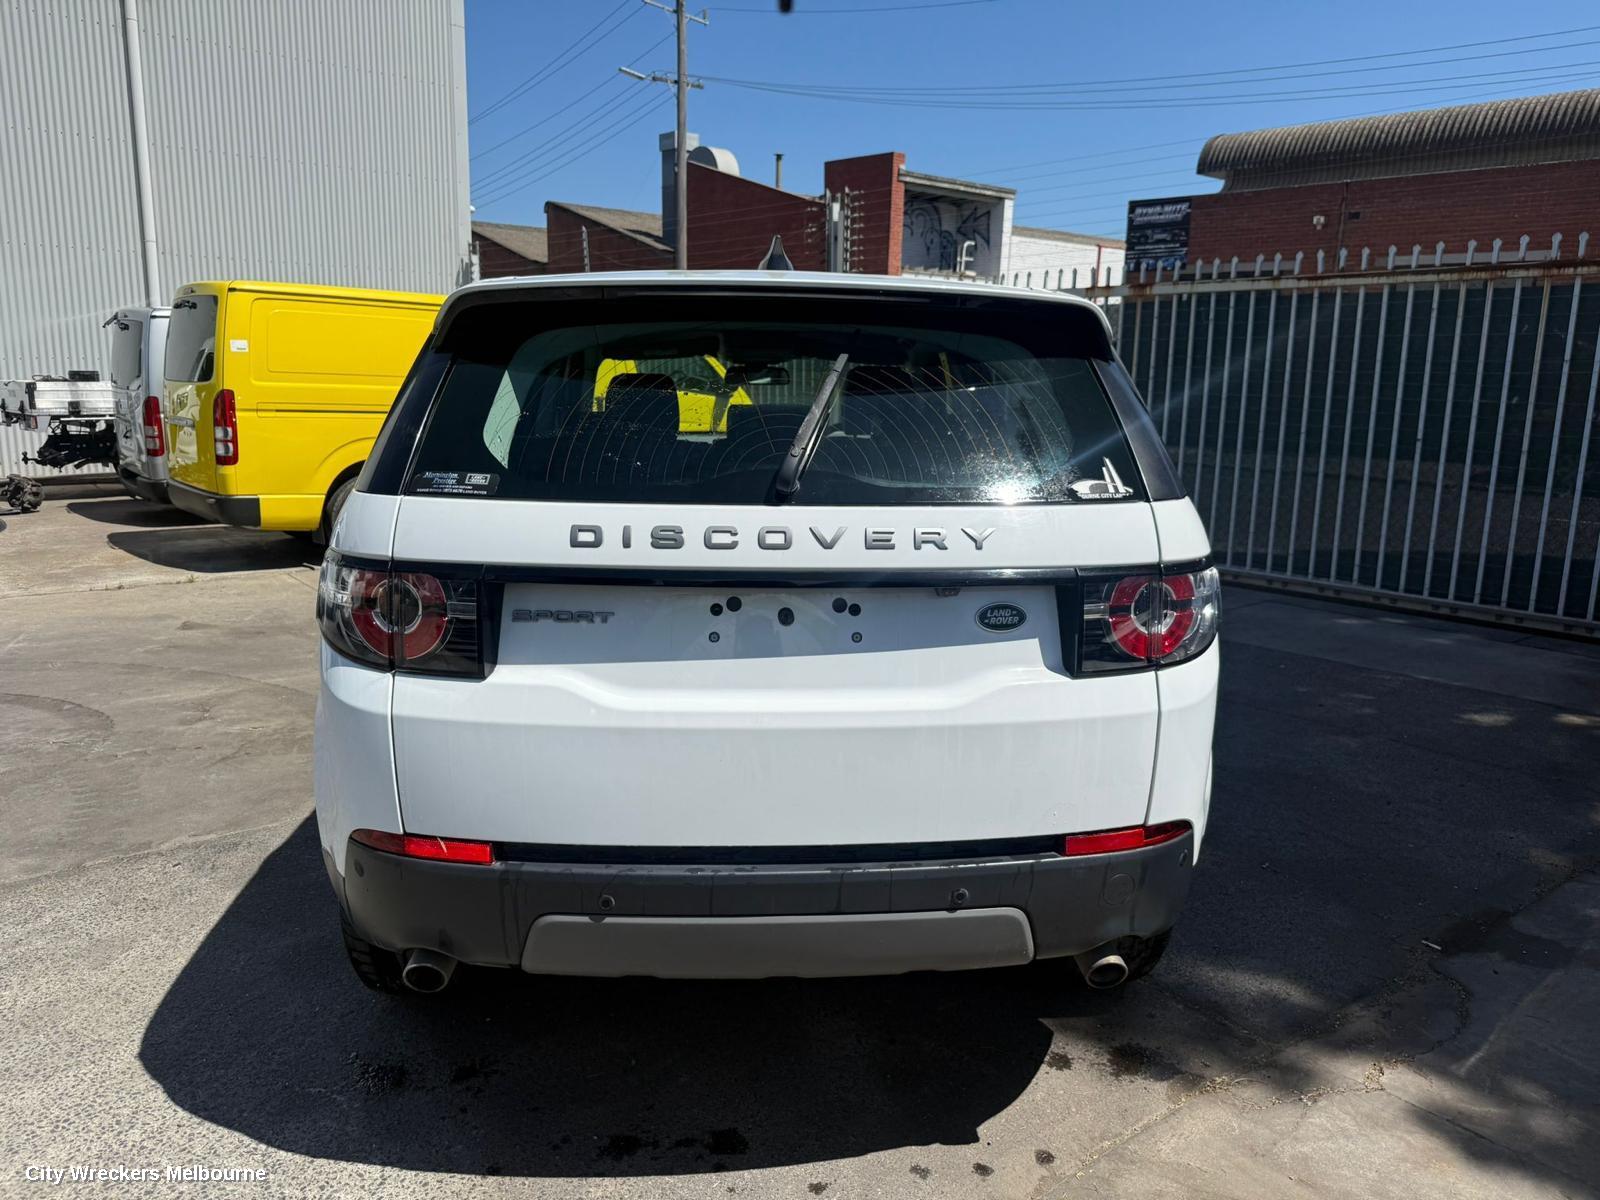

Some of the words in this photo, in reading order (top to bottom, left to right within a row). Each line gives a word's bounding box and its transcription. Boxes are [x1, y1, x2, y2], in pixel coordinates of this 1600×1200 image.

[570, 524, 996, 550] DISCOVERY
[512, 609, 615, 624] SPORT
[987, 609, 1012, 617] LAND
[989, 616, 1019, 625] ROVER
